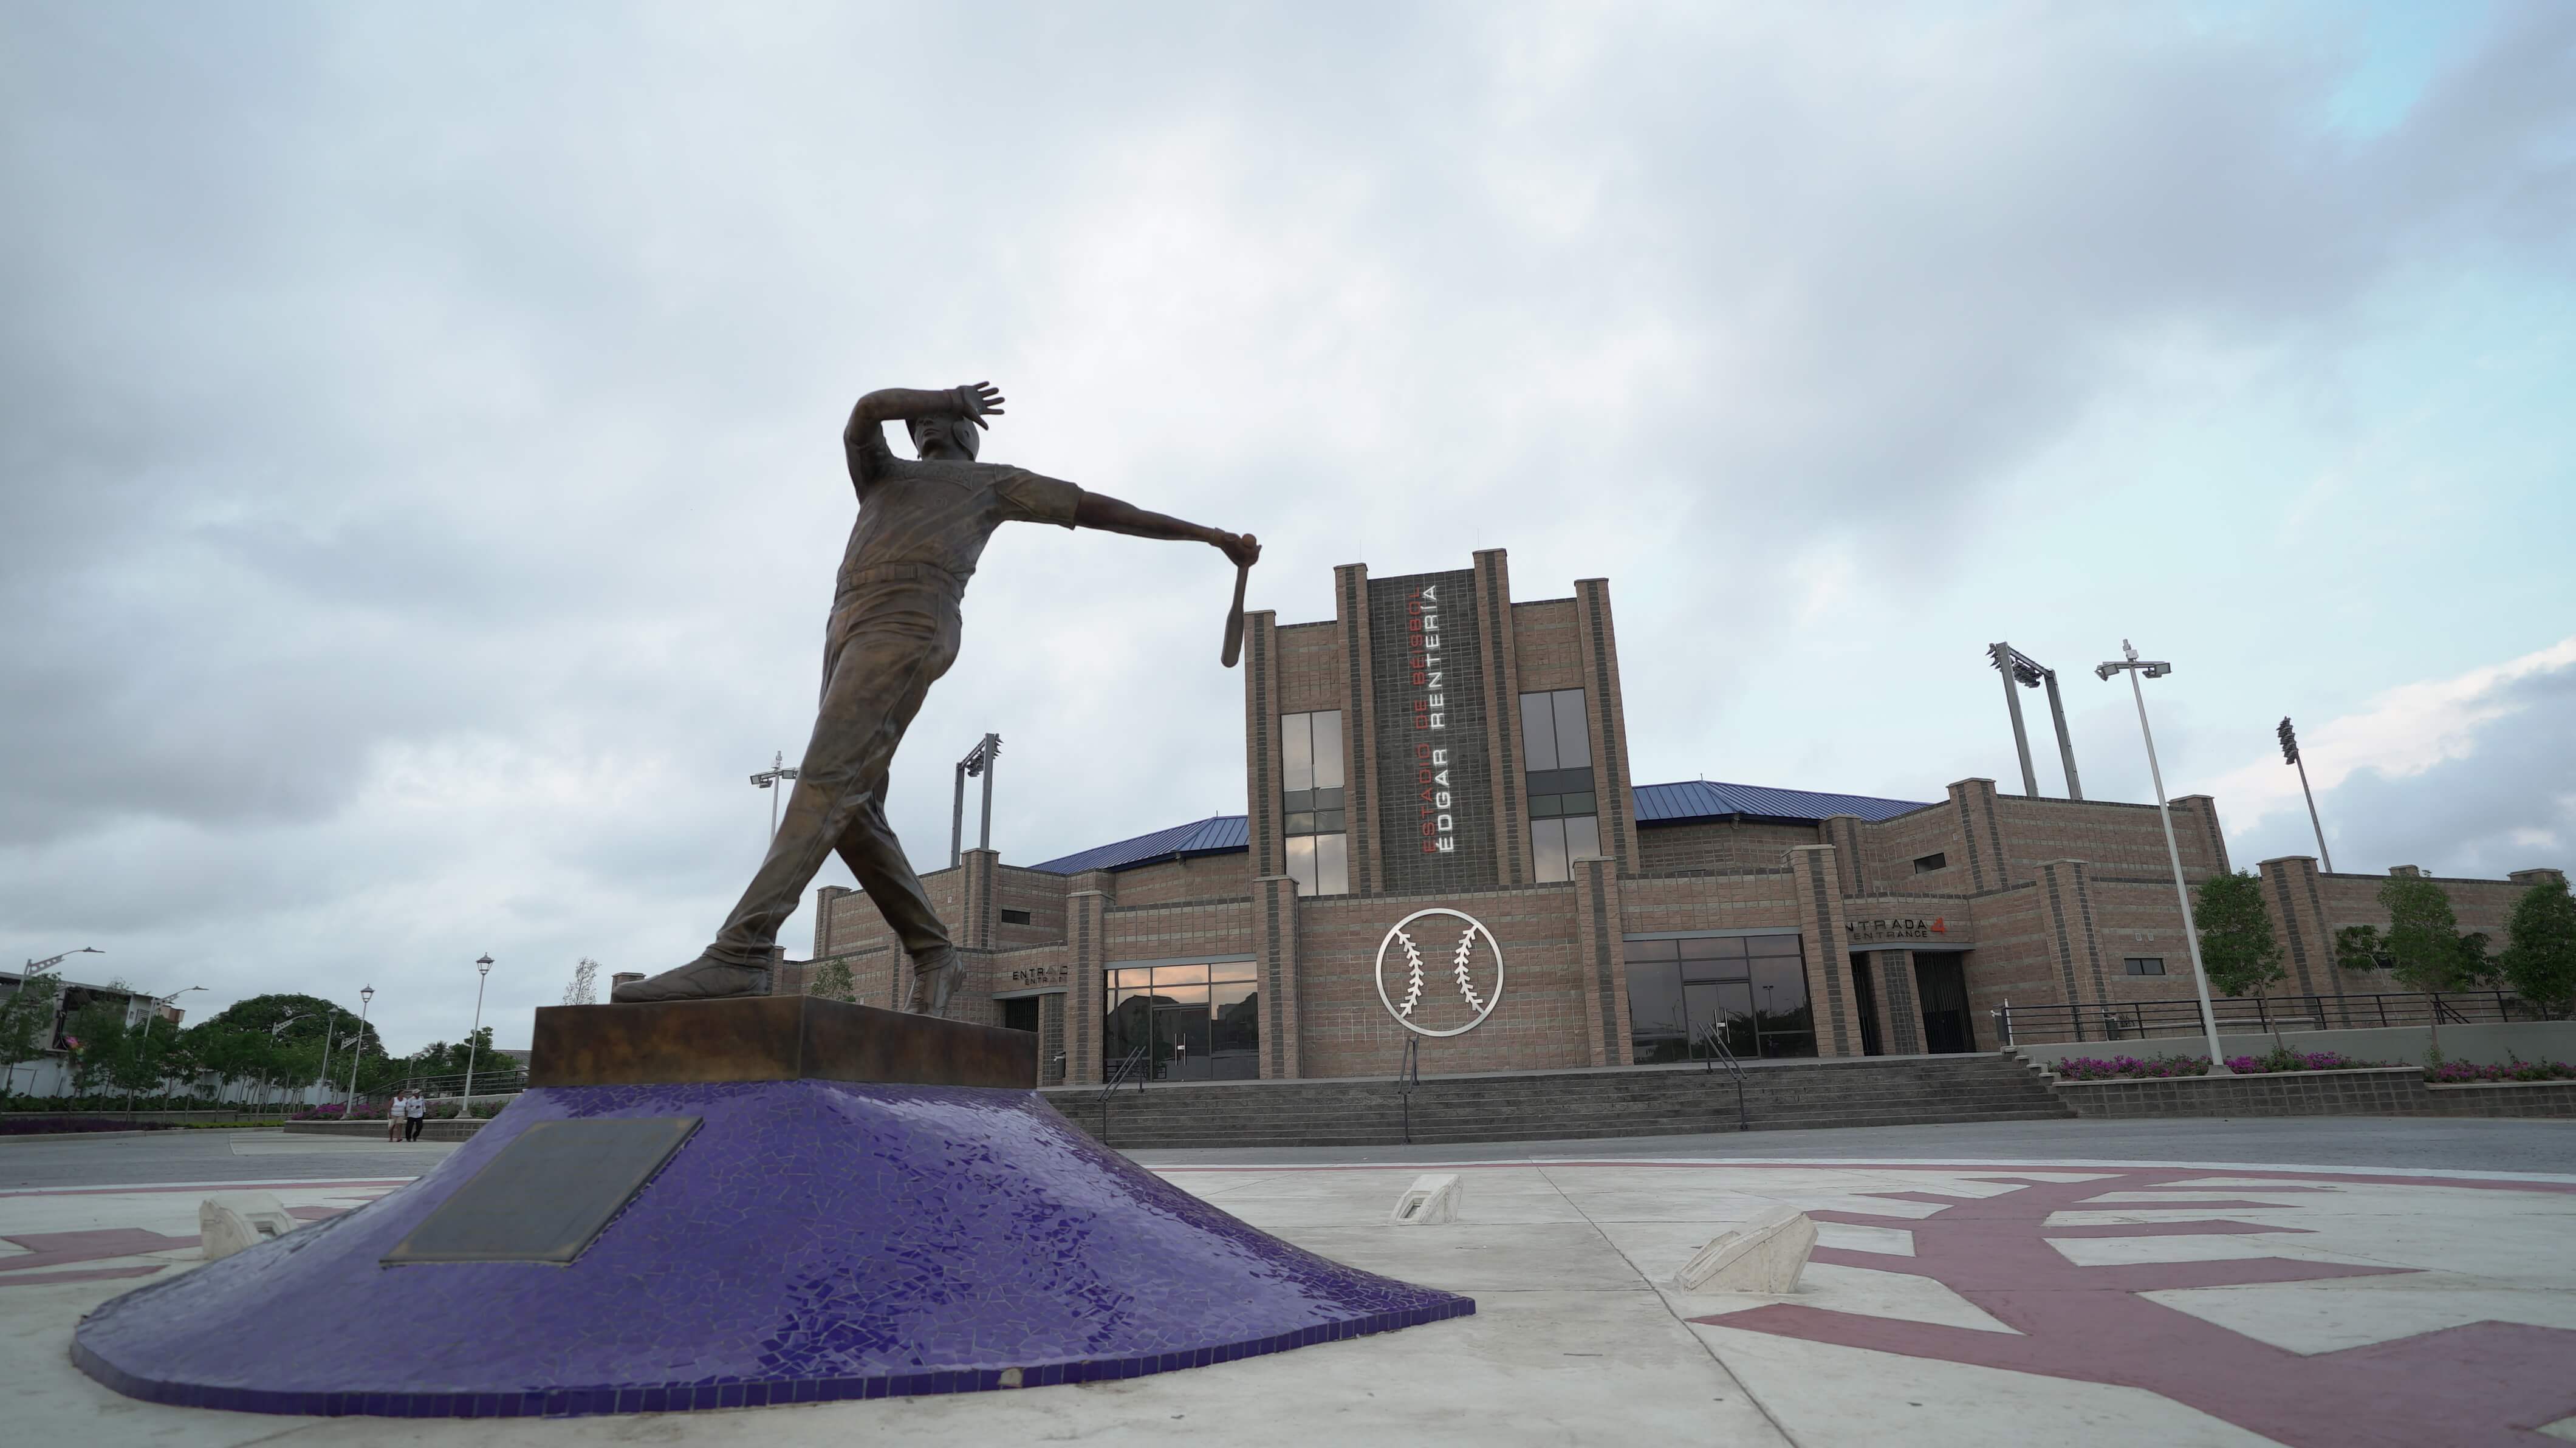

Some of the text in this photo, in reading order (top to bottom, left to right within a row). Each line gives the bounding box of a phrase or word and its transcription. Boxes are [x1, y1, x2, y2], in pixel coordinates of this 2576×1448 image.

[1409, 587, 1436, 852] ESTADIO DE BÉISBOL
[1420, 585, 1454, 852] ÉDGAR RENTERÍA
[1845, 917, 1945, 934] NTRADA 4
[1854, 930, 1928, 940] ENTRANCE
[1013, 966, 1067, 980] ENTRAD
